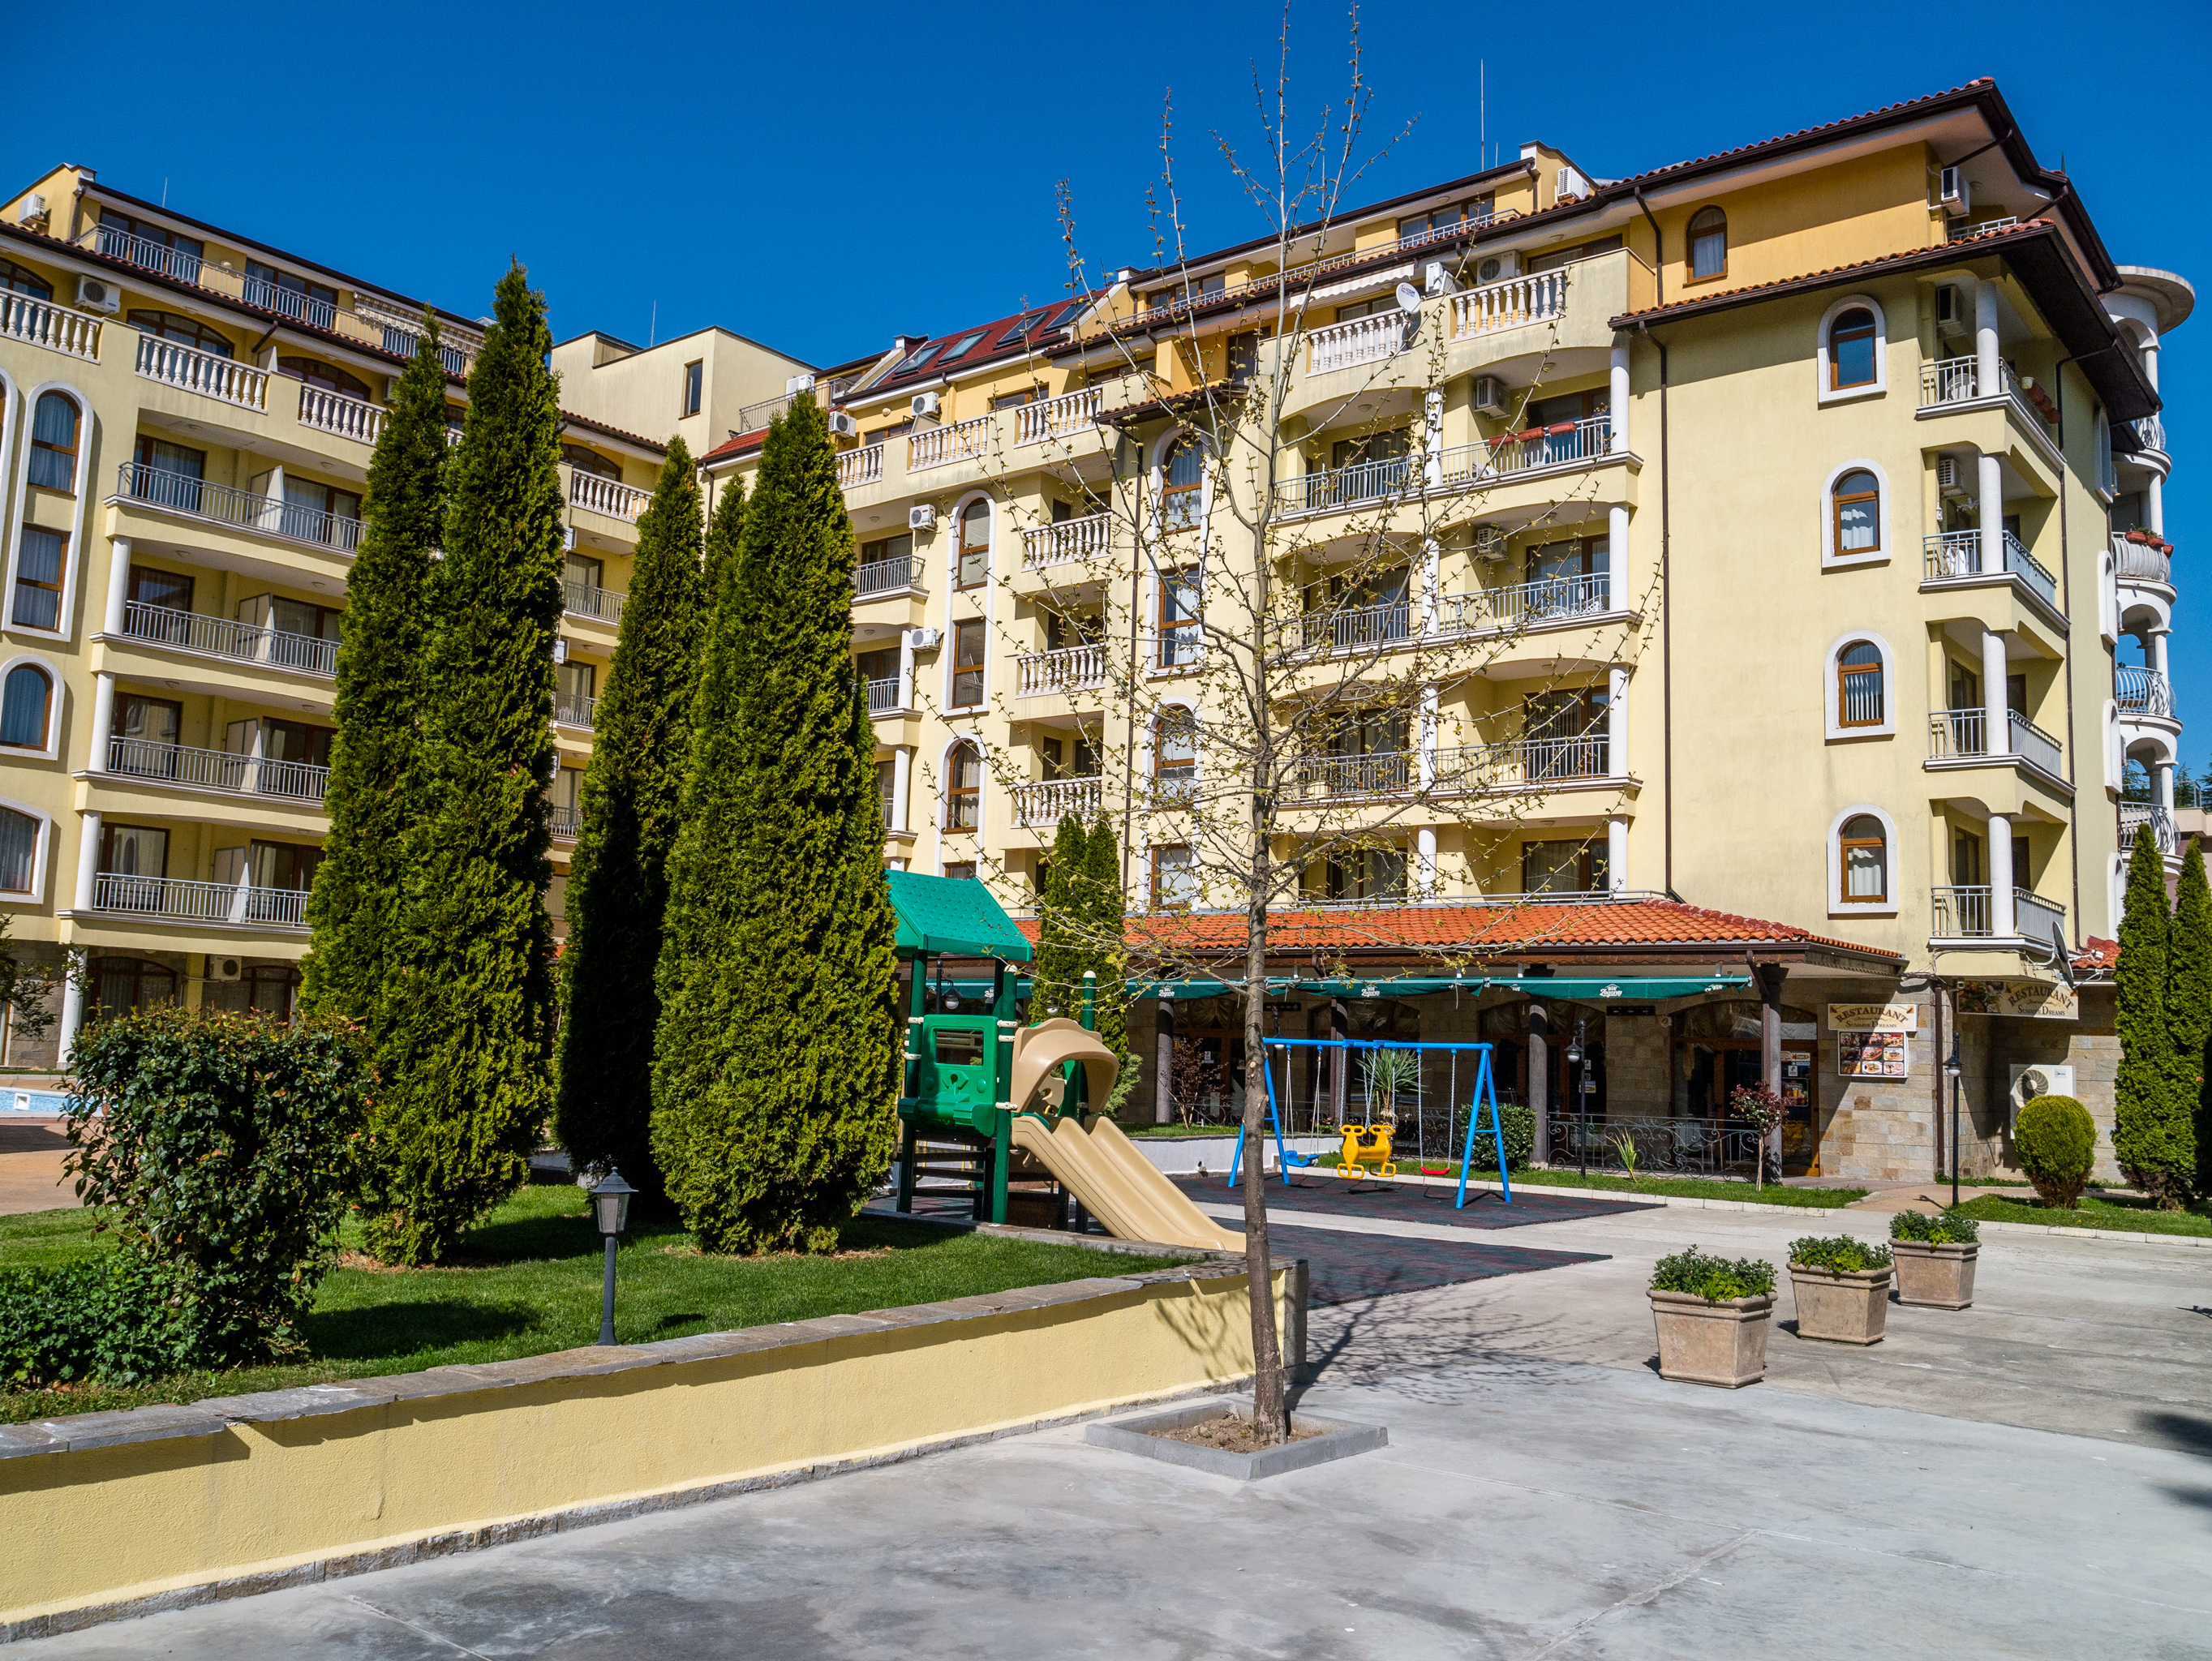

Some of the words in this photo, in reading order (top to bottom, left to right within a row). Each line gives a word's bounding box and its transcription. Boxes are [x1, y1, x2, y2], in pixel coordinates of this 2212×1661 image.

[2008, 986, 2073, 1010] RESTAURANT
[1835, 1006, 1909, 1024] RESTAURANT
[2042, 1006, 2066, 1016] DREAMS
